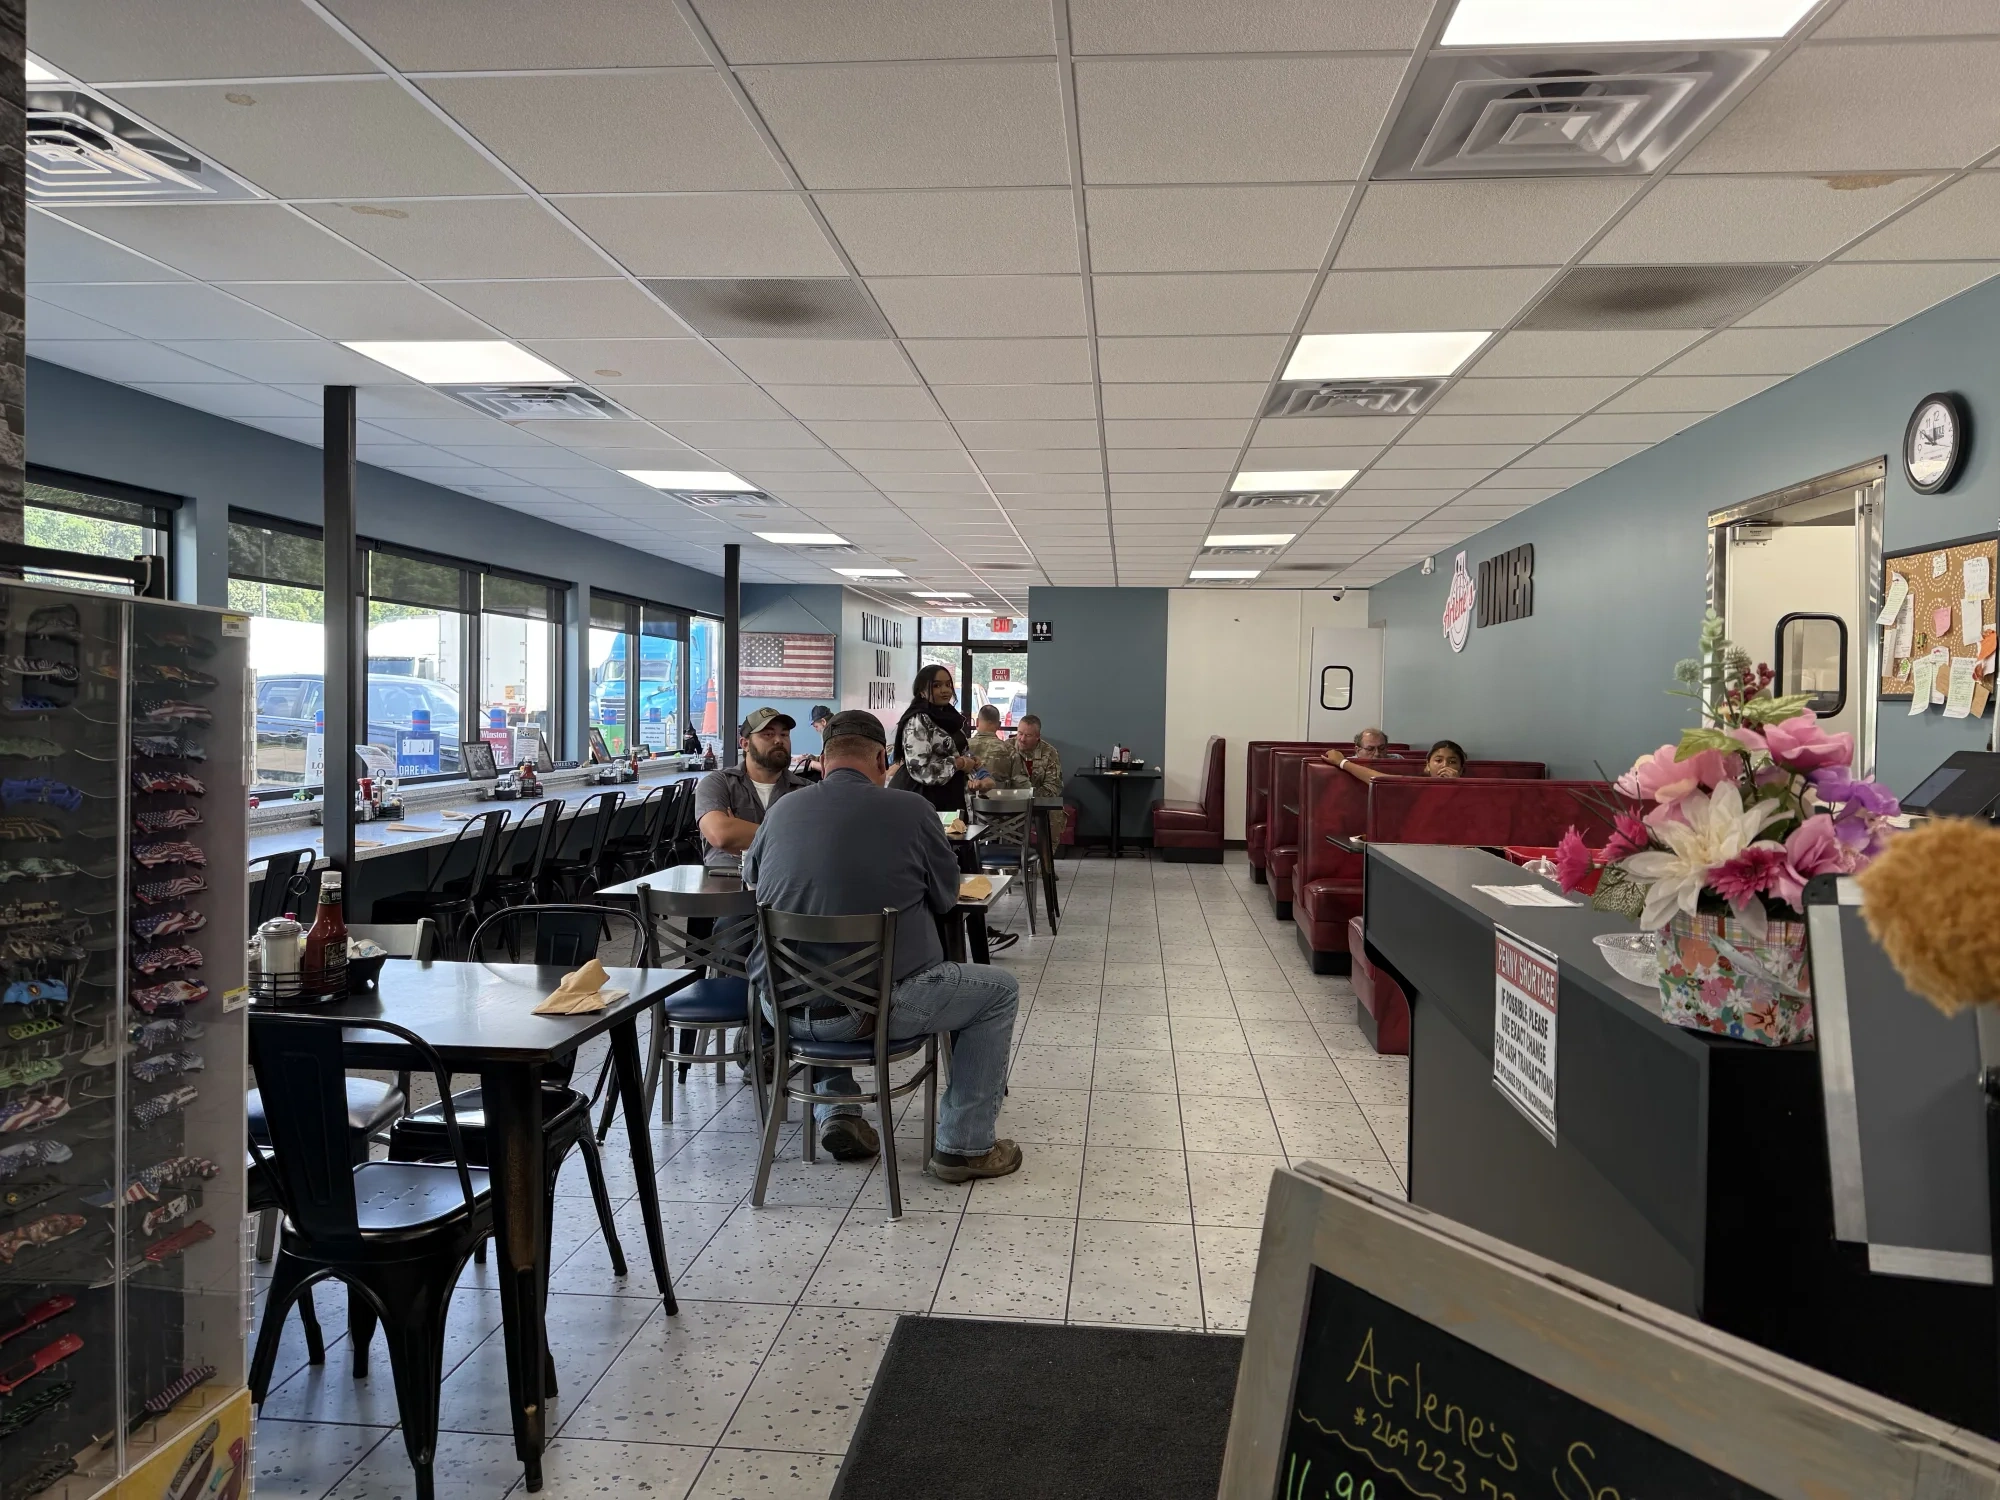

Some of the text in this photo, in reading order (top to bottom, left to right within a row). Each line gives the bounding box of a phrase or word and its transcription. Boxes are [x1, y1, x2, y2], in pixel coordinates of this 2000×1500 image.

[1934, 410, 1940, 422] 12
[1477, 543, 1534, 628] DINER
[995, 619, 1008, 632] EXIT
[480, 730, 508, 739] Winston
[399, 765, 420, 775] DARE
[1498, 943, 1555, 1007] PENNY SHORTAGE
[1501, 986, 1549, 1040] IF POSSIBLE, PLEASE
[1501, 1012, 1547, 1066] USE EXACT CHANGE
[1496, 1031, 1554, 1100] FOR CASH TRANSACTIONS
[1346, 1327, 1518, 1472] Arlene's
[1371, 1413, 1409, 1456] 269
[1415, 1440, 1467, 1494] 223
